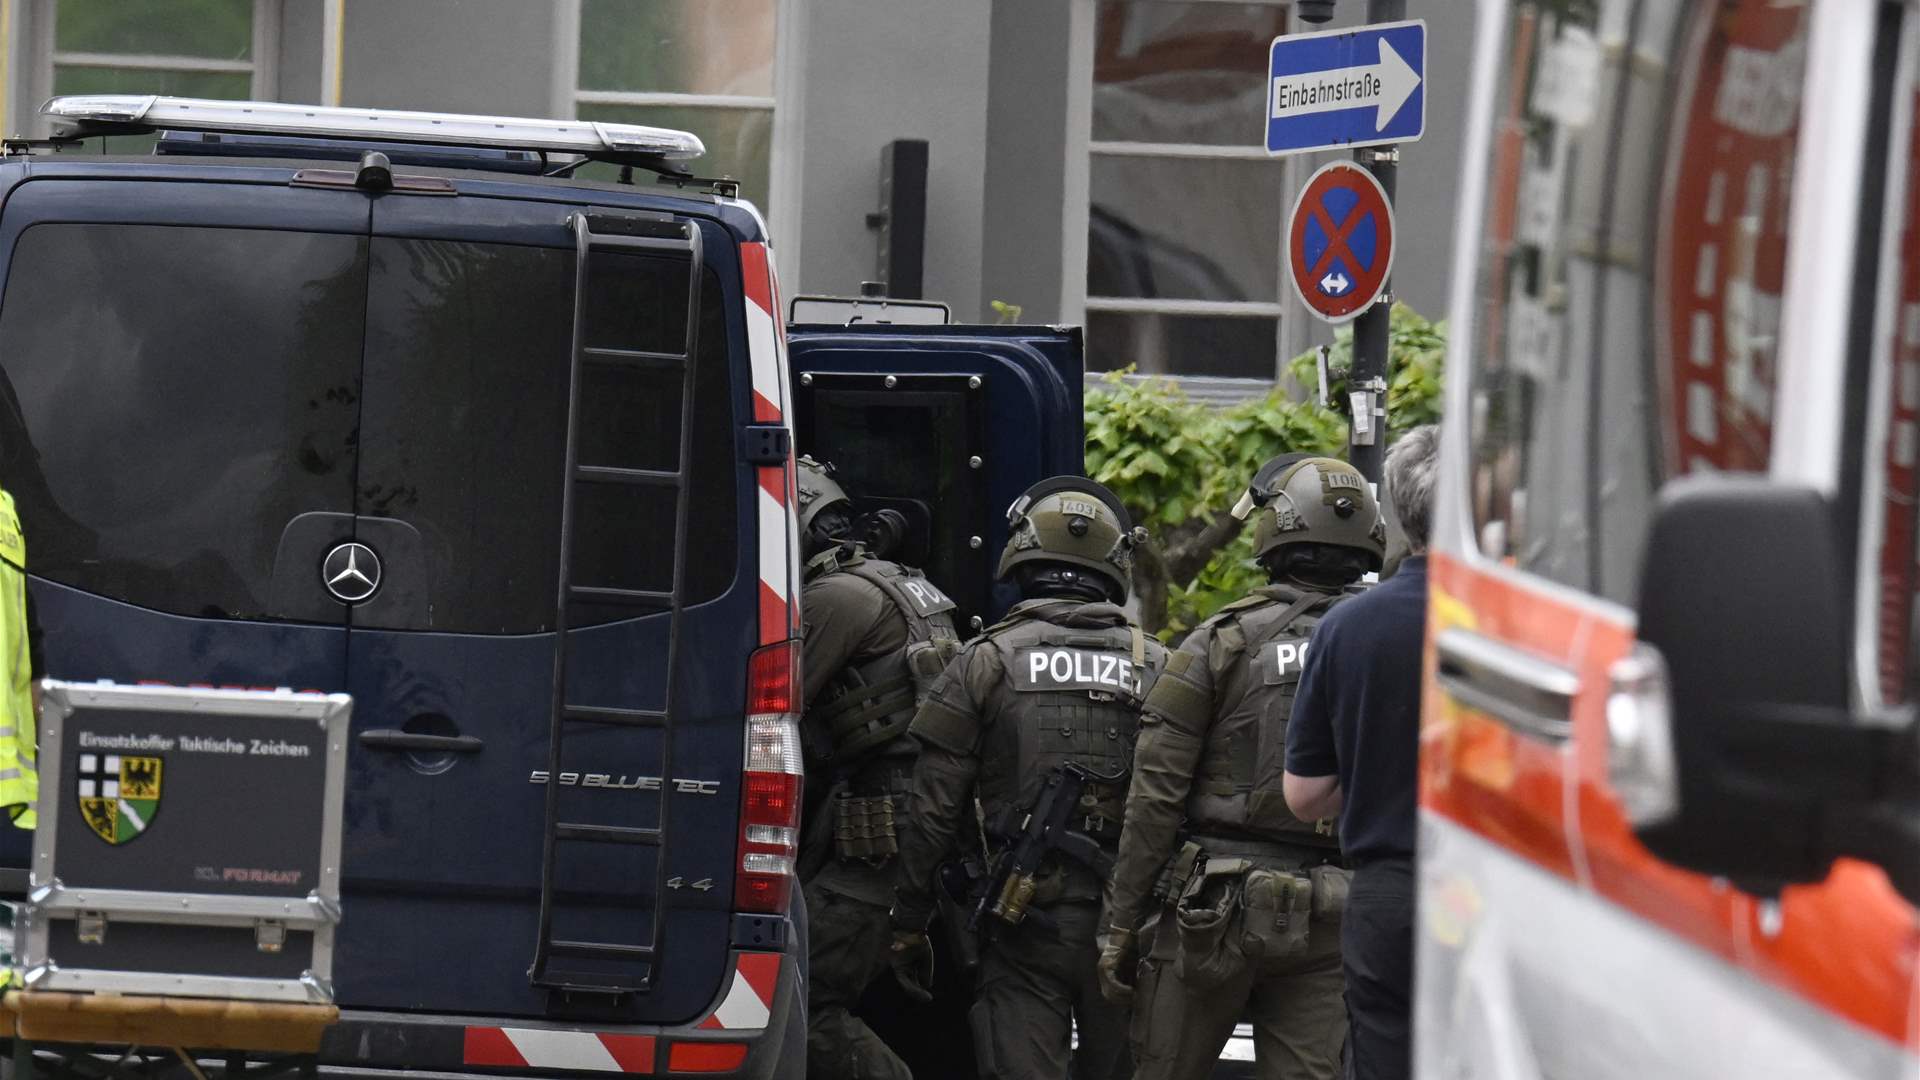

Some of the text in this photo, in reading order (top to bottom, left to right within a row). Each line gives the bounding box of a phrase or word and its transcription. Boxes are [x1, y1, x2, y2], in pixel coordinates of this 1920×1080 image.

[1279, 73, 1381, 109] Einbahnstraße
[1066, 501, 1093, 515] 403
[79, 731, 310, 757] Einsatzkoffer Taktische Zeichen
[528, 770, 580, 786] 59
[223, 867, 302, 885] FORMAT
